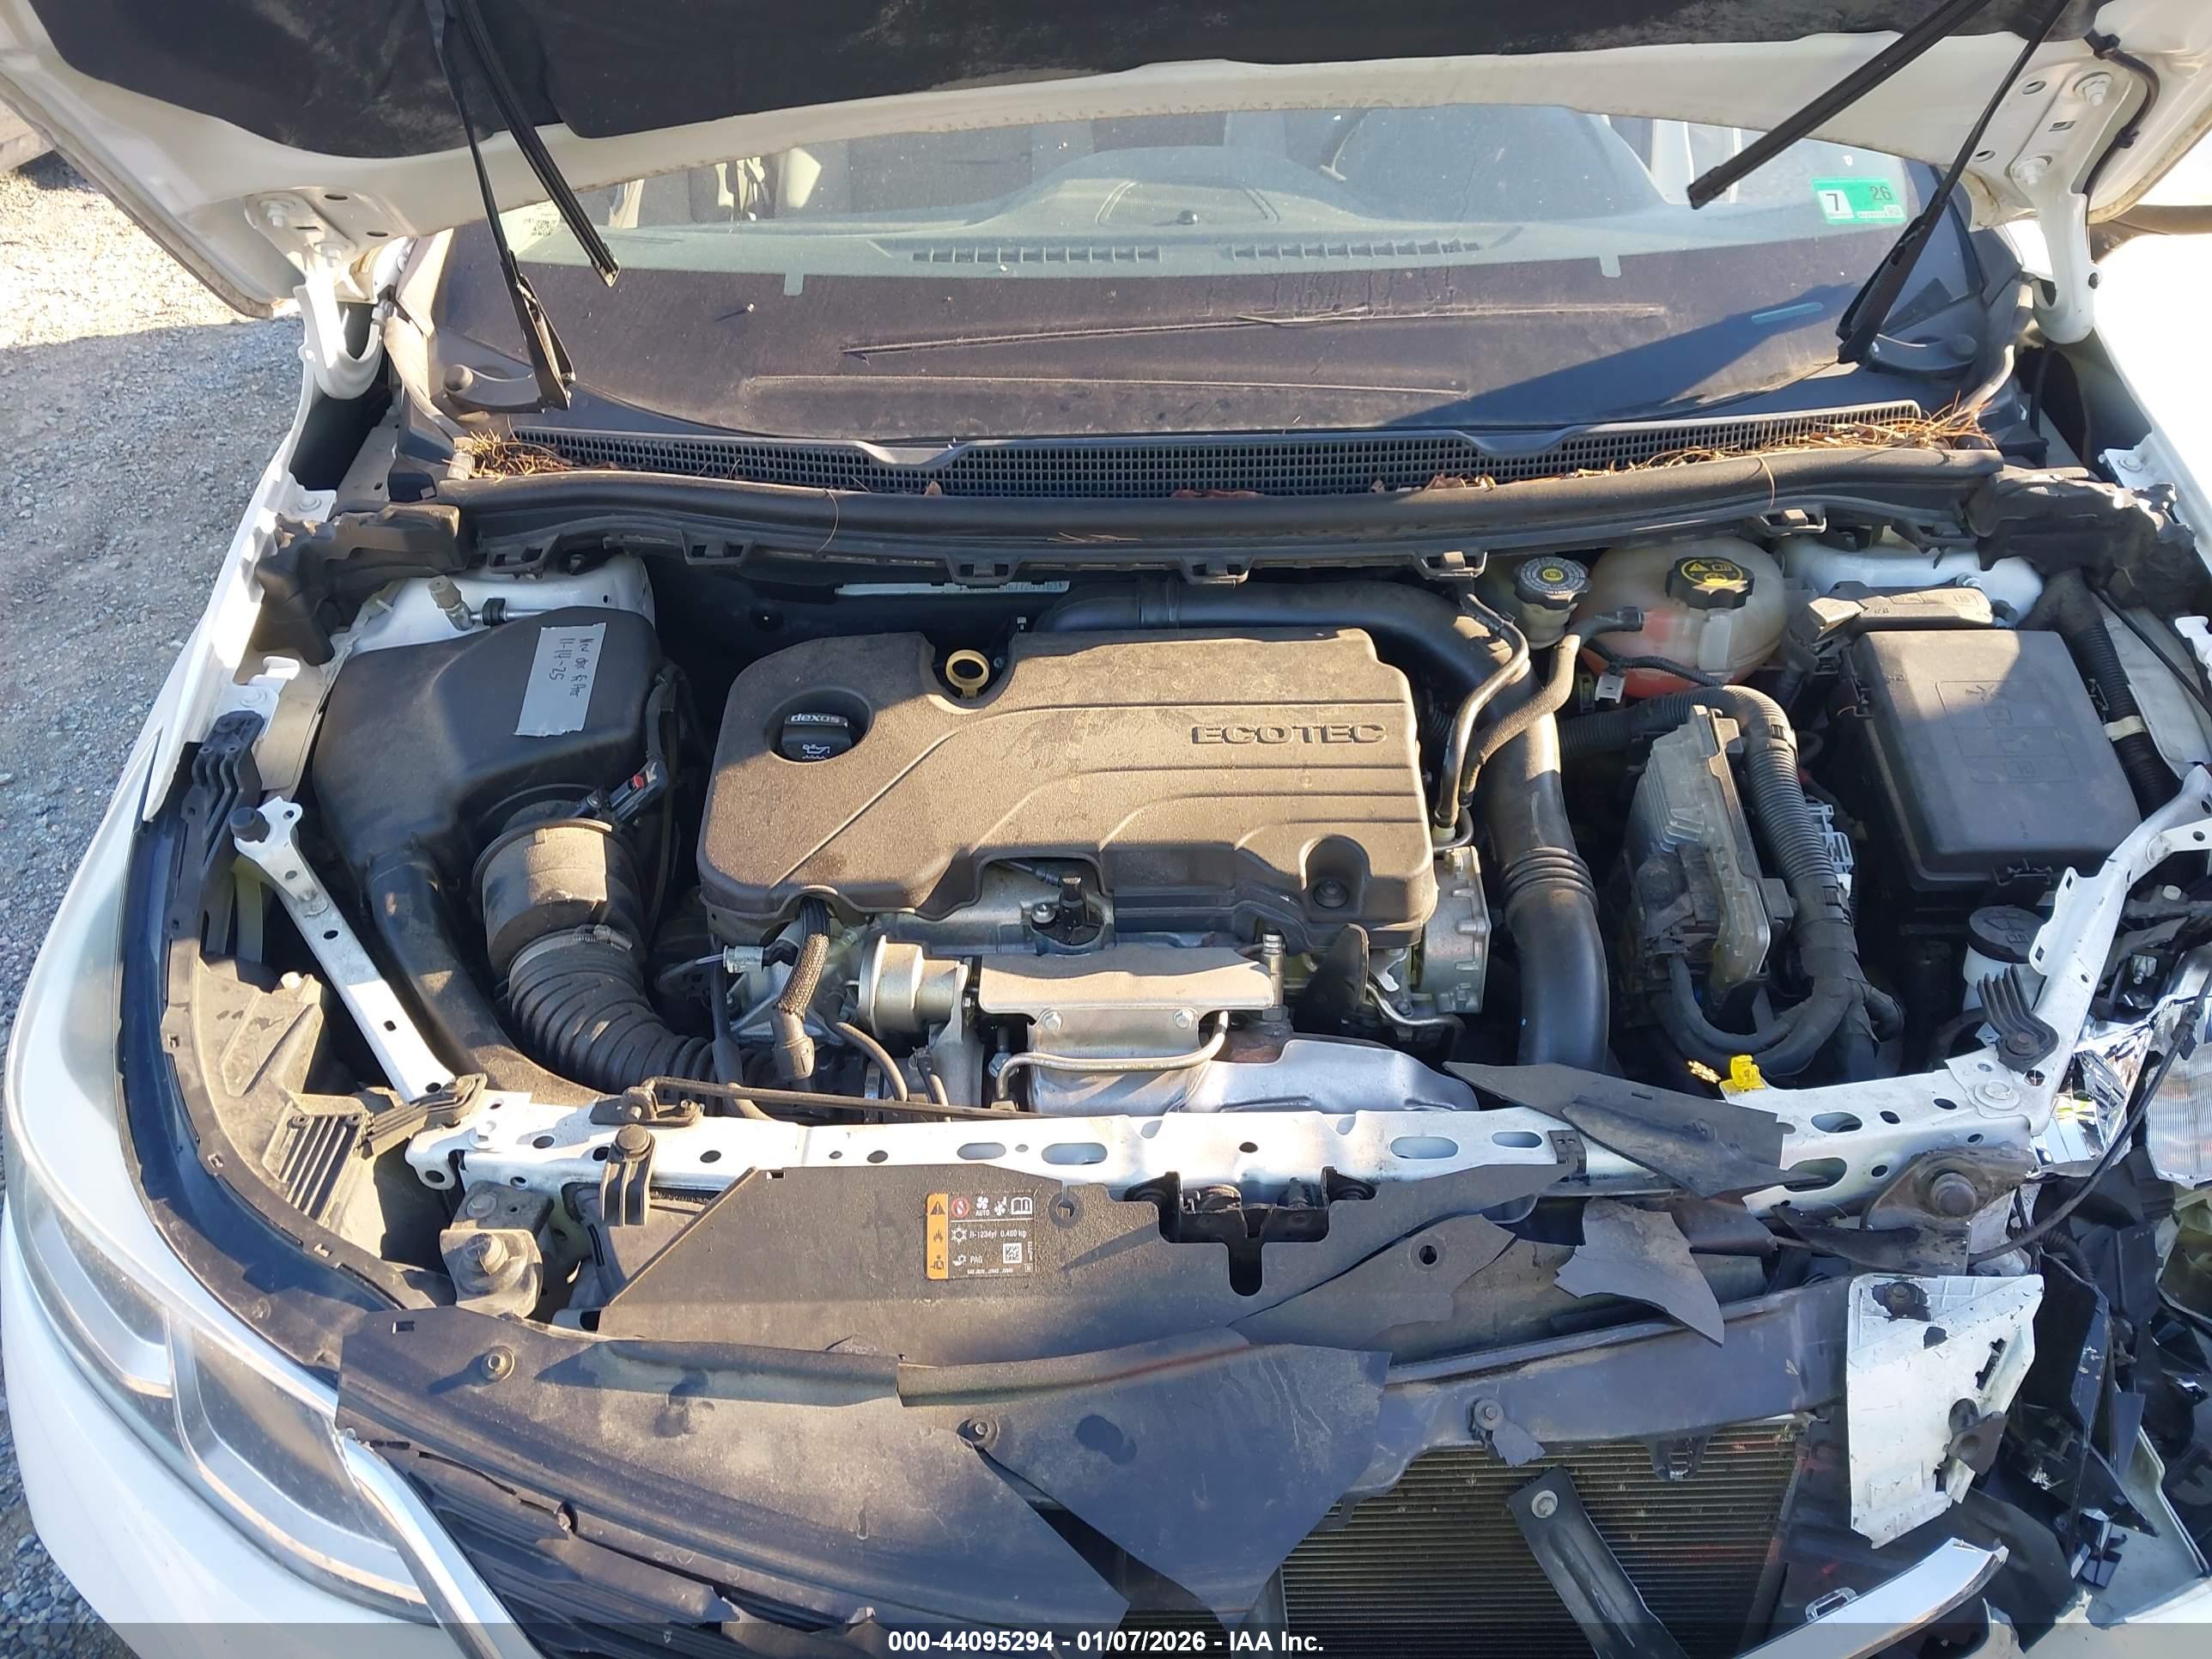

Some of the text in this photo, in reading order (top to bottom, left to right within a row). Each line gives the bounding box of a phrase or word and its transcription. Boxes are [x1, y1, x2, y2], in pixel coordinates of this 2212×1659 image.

[1869, 185, 1893, 201] 26
[1826, 193, 1839, 212] 7
[791, 713, 840, 723] dexos
[1191, 723, 1387, 745] ECOTEC
[969, 1255, 983, 1265] PAG
